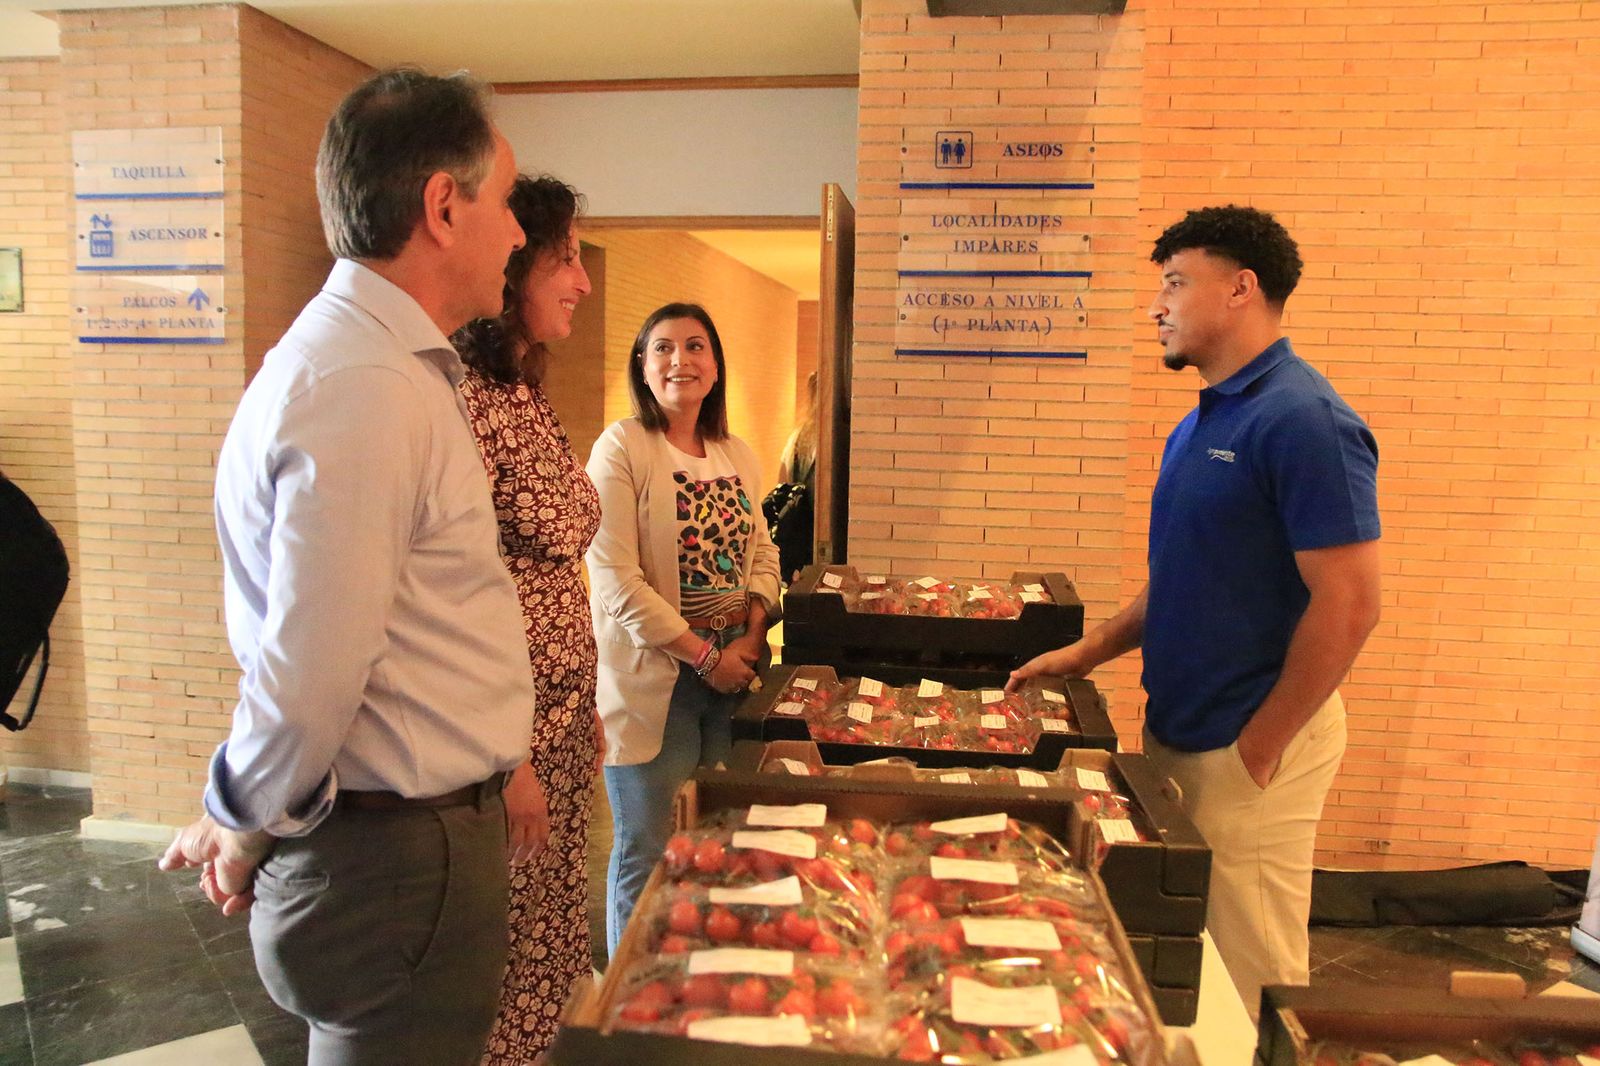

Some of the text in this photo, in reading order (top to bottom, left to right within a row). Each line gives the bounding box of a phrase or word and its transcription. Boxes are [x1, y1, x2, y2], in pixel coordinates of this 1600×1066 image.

[1002, 143, 1063, 157] ASEOS
[111, 165, 186, 180] TAQUILLA
[932, 214, 1062, 228] LOCALIDADES
[128, 227, 208, 241] ASCENSOR
[953, 240, 1038, 253] IMPARES
[123, 296, 176, 308] PALCOS
[903, 293, 1084, 309] ACCESO A NIVEL A
[159, 317, 215, 329] PLANTA
